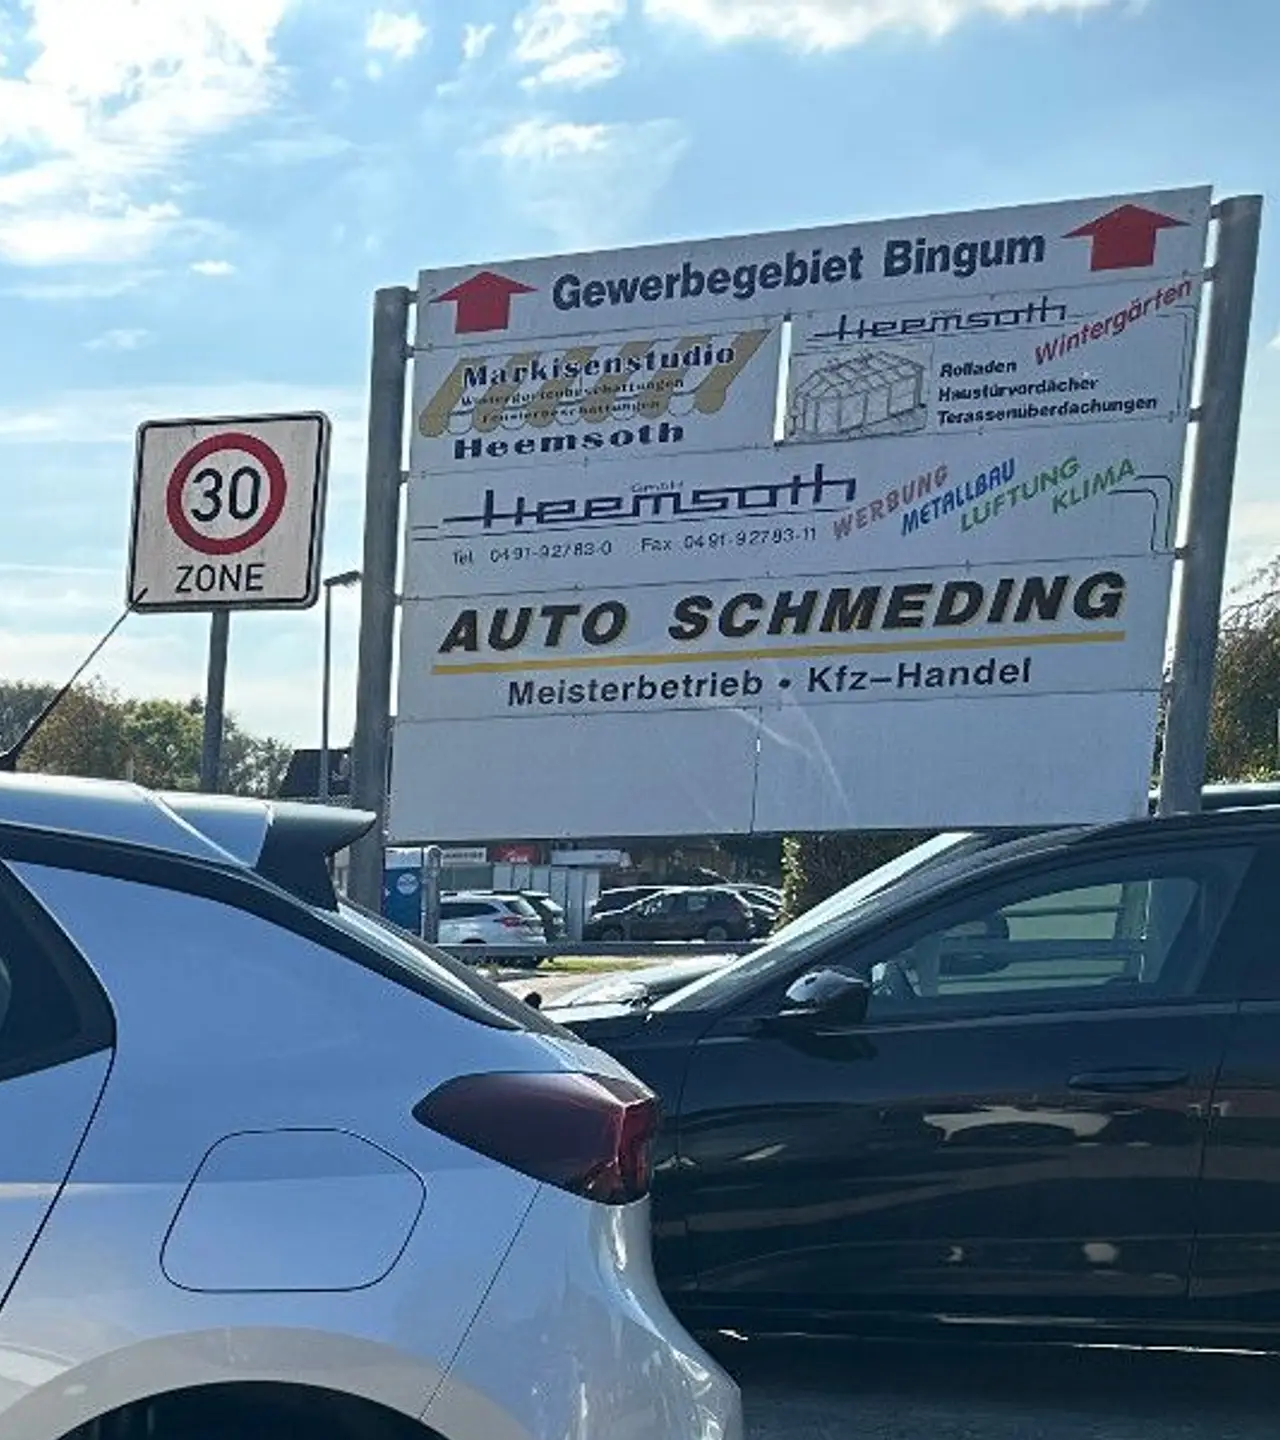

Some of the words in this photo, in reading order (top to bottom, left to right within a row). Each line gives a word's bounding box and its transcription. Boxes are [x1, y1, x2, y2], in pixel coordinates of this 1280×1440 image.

[552, 247, 864, 311] Gewerbegebiet
[883, 233, 1046, 279] Bingum
[814, 295, 1067, 341] Heemsoth
[1034, 279, 1193, 366] Wintergärten
[461, 343, 737, 389] Markisenstudio
[940, 359, 1018, 378] Rolladen
[937, 397, 1158, 425] Terassenüberdachungen
[453, 421, 685, 460] Heemsoth
[190, 465, 262, 523] 30
[442, 462, 857, 529] Heemsoth
[832, 464, 949, 540] WERBUNG
[901, 457, 1016, 537] METALLBAU
[1051, 458, 1136, 515] KLIMA
[640, 537, 673, 551] Fax
[175, 563, 267, 594] ZONE
[437, 600, 629, 653] AUTO
[668, 570, 1127, 642] SCHMEDING
[507, 669, 764, 707] Meisterbetrieb
[806, 657, 1033, 693] Kfz-Handel
